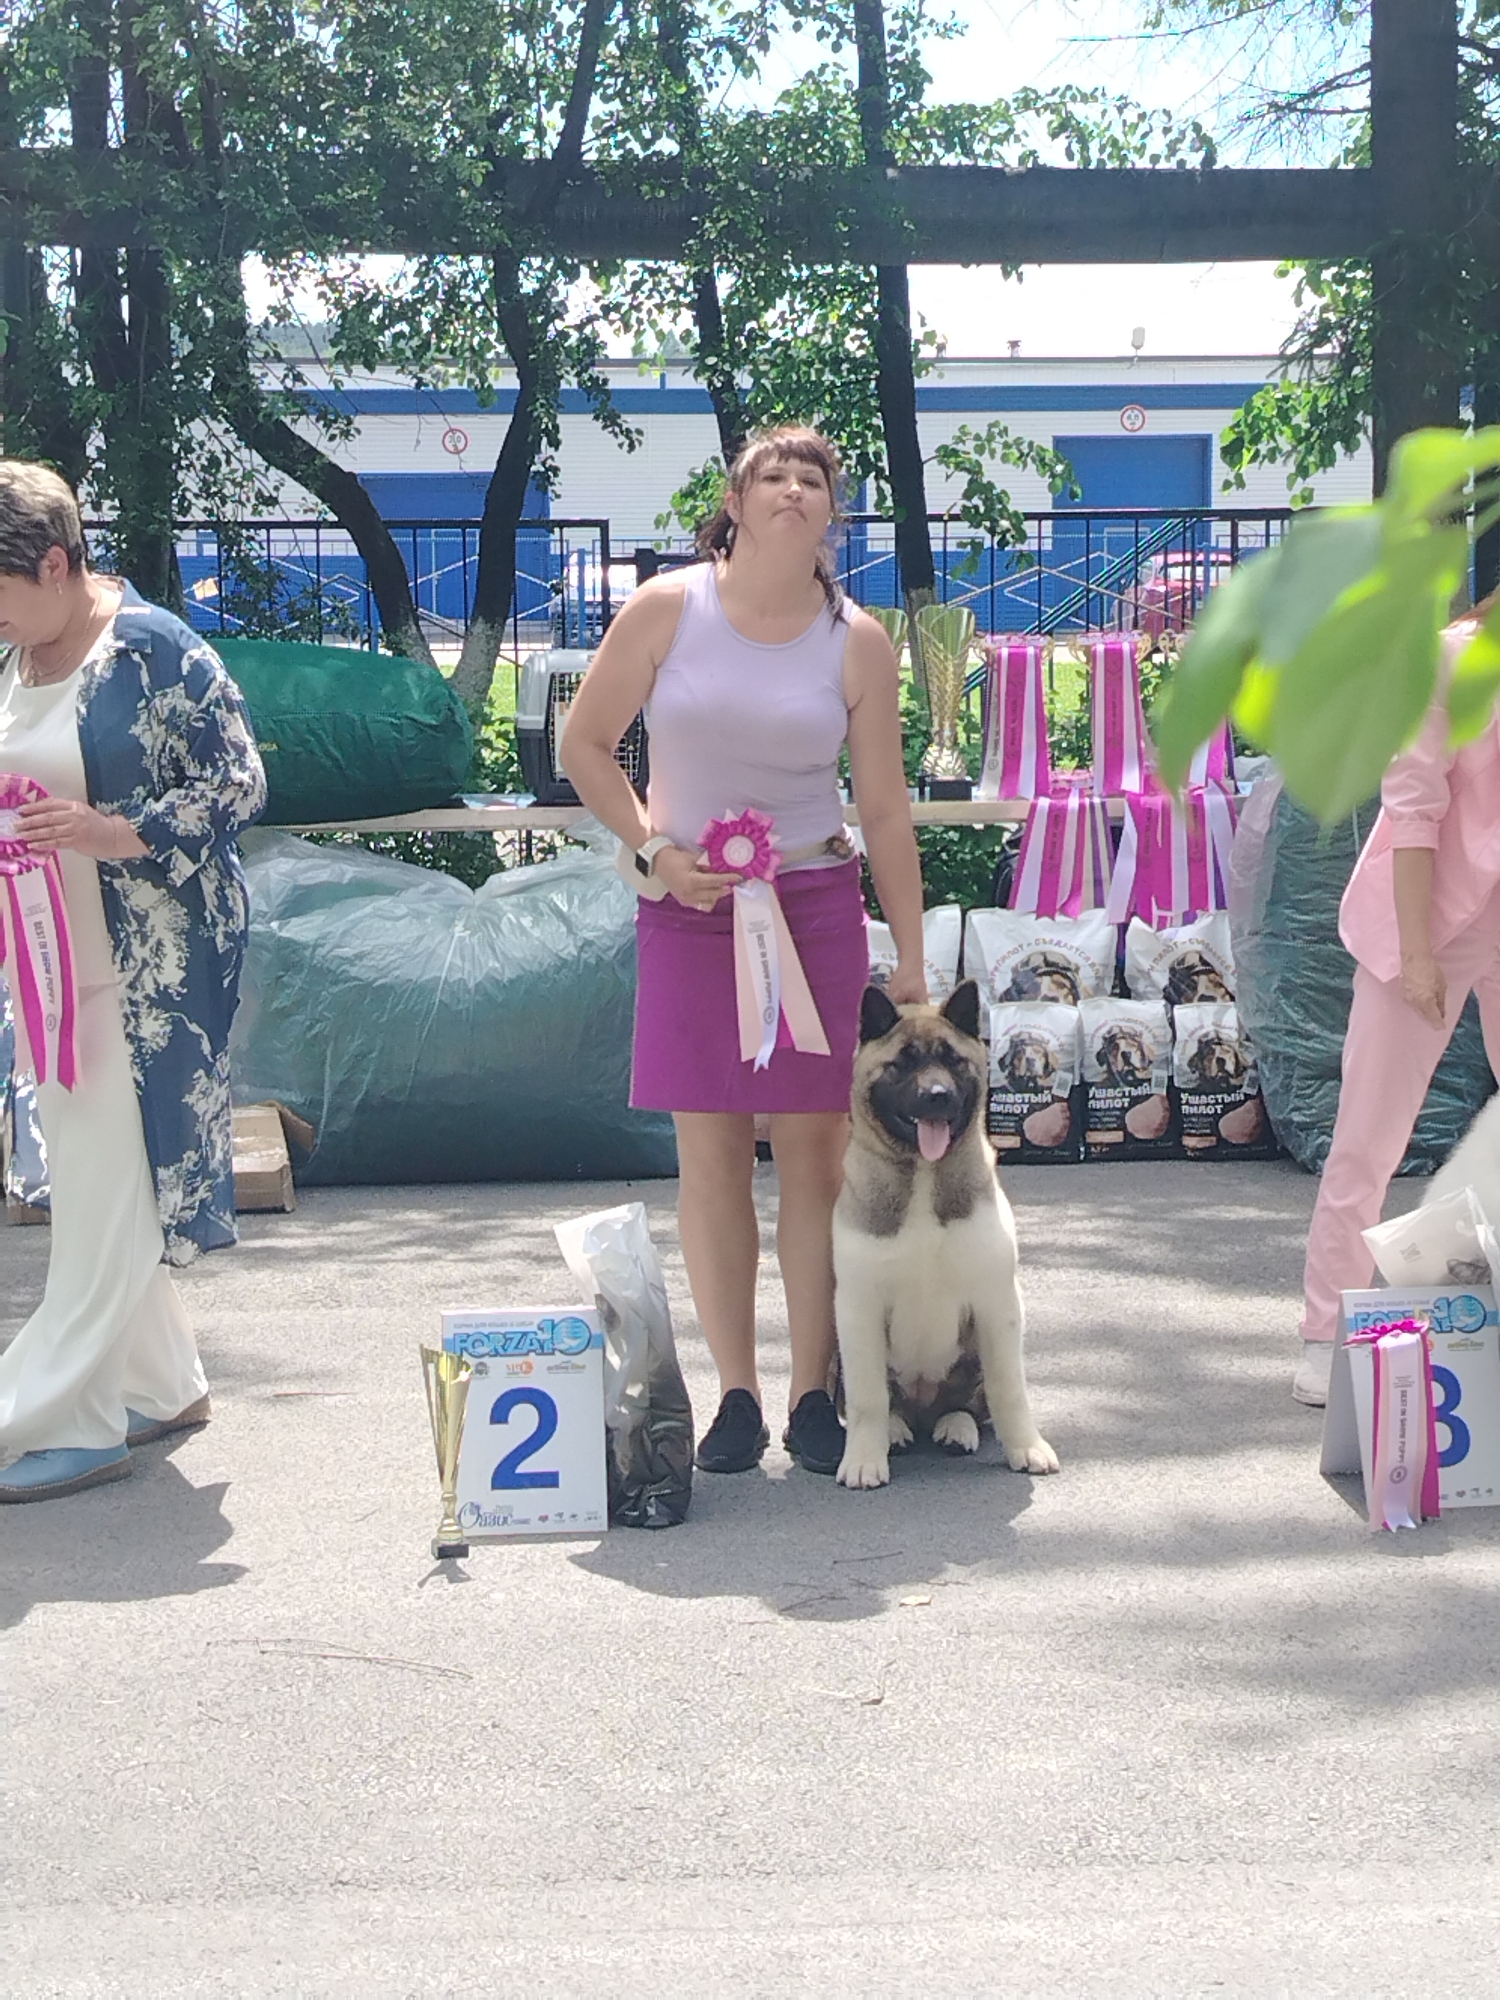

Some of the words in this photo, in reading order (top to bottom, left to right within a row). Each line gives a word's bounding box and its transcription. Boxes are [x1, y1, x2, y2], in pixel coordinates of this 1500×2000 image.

[33, 920, 46, 940] BEST
[1353, 1295, 1487, 1333] FOR10
[453, 1316, 592, 1358] FORZA10
[489, 1387, 560, 1491] 2
